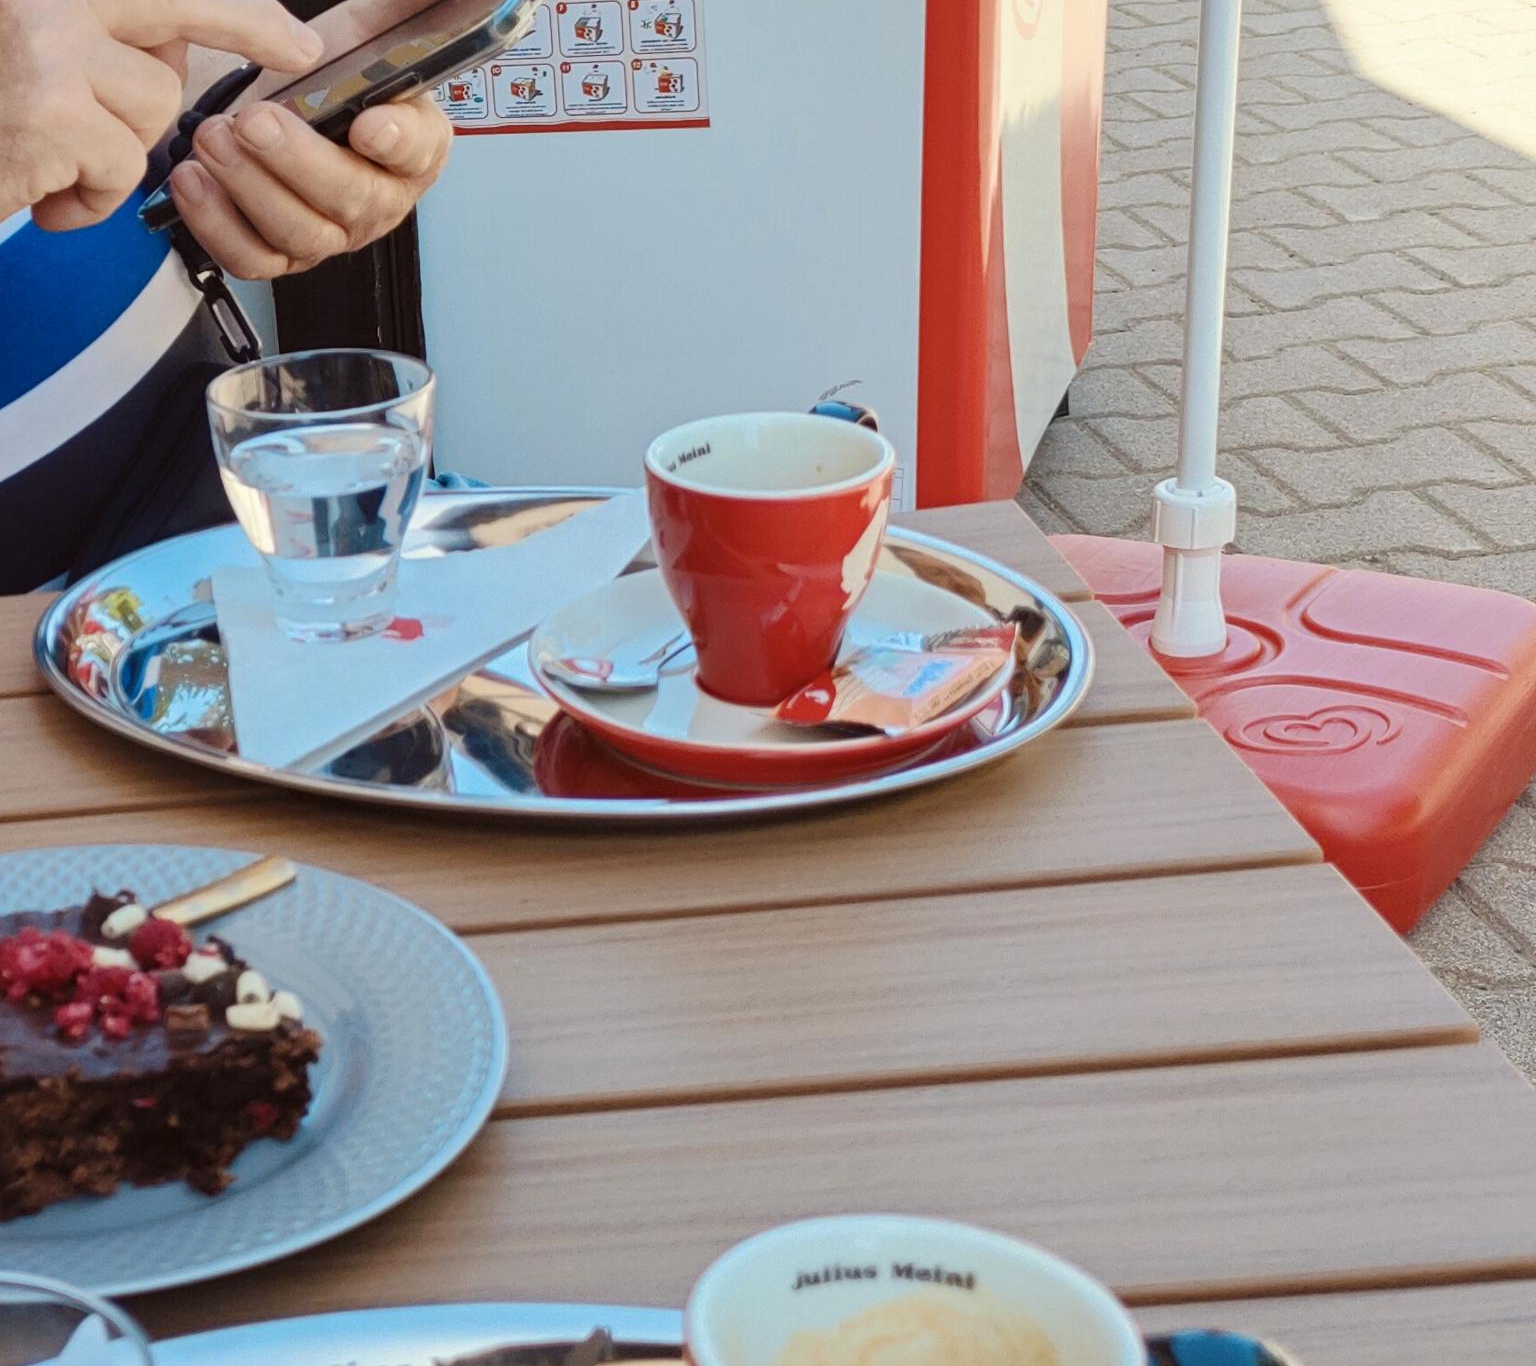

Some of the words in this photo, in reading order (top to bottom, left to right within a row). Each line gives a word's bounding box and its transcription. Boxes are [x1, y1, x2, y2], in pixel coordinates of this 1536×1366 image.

[677, 442, 710, 466] Meinl
[791, 1263, 878, 1291] Julius
[891, 1261, 976, 1291] Meinl
